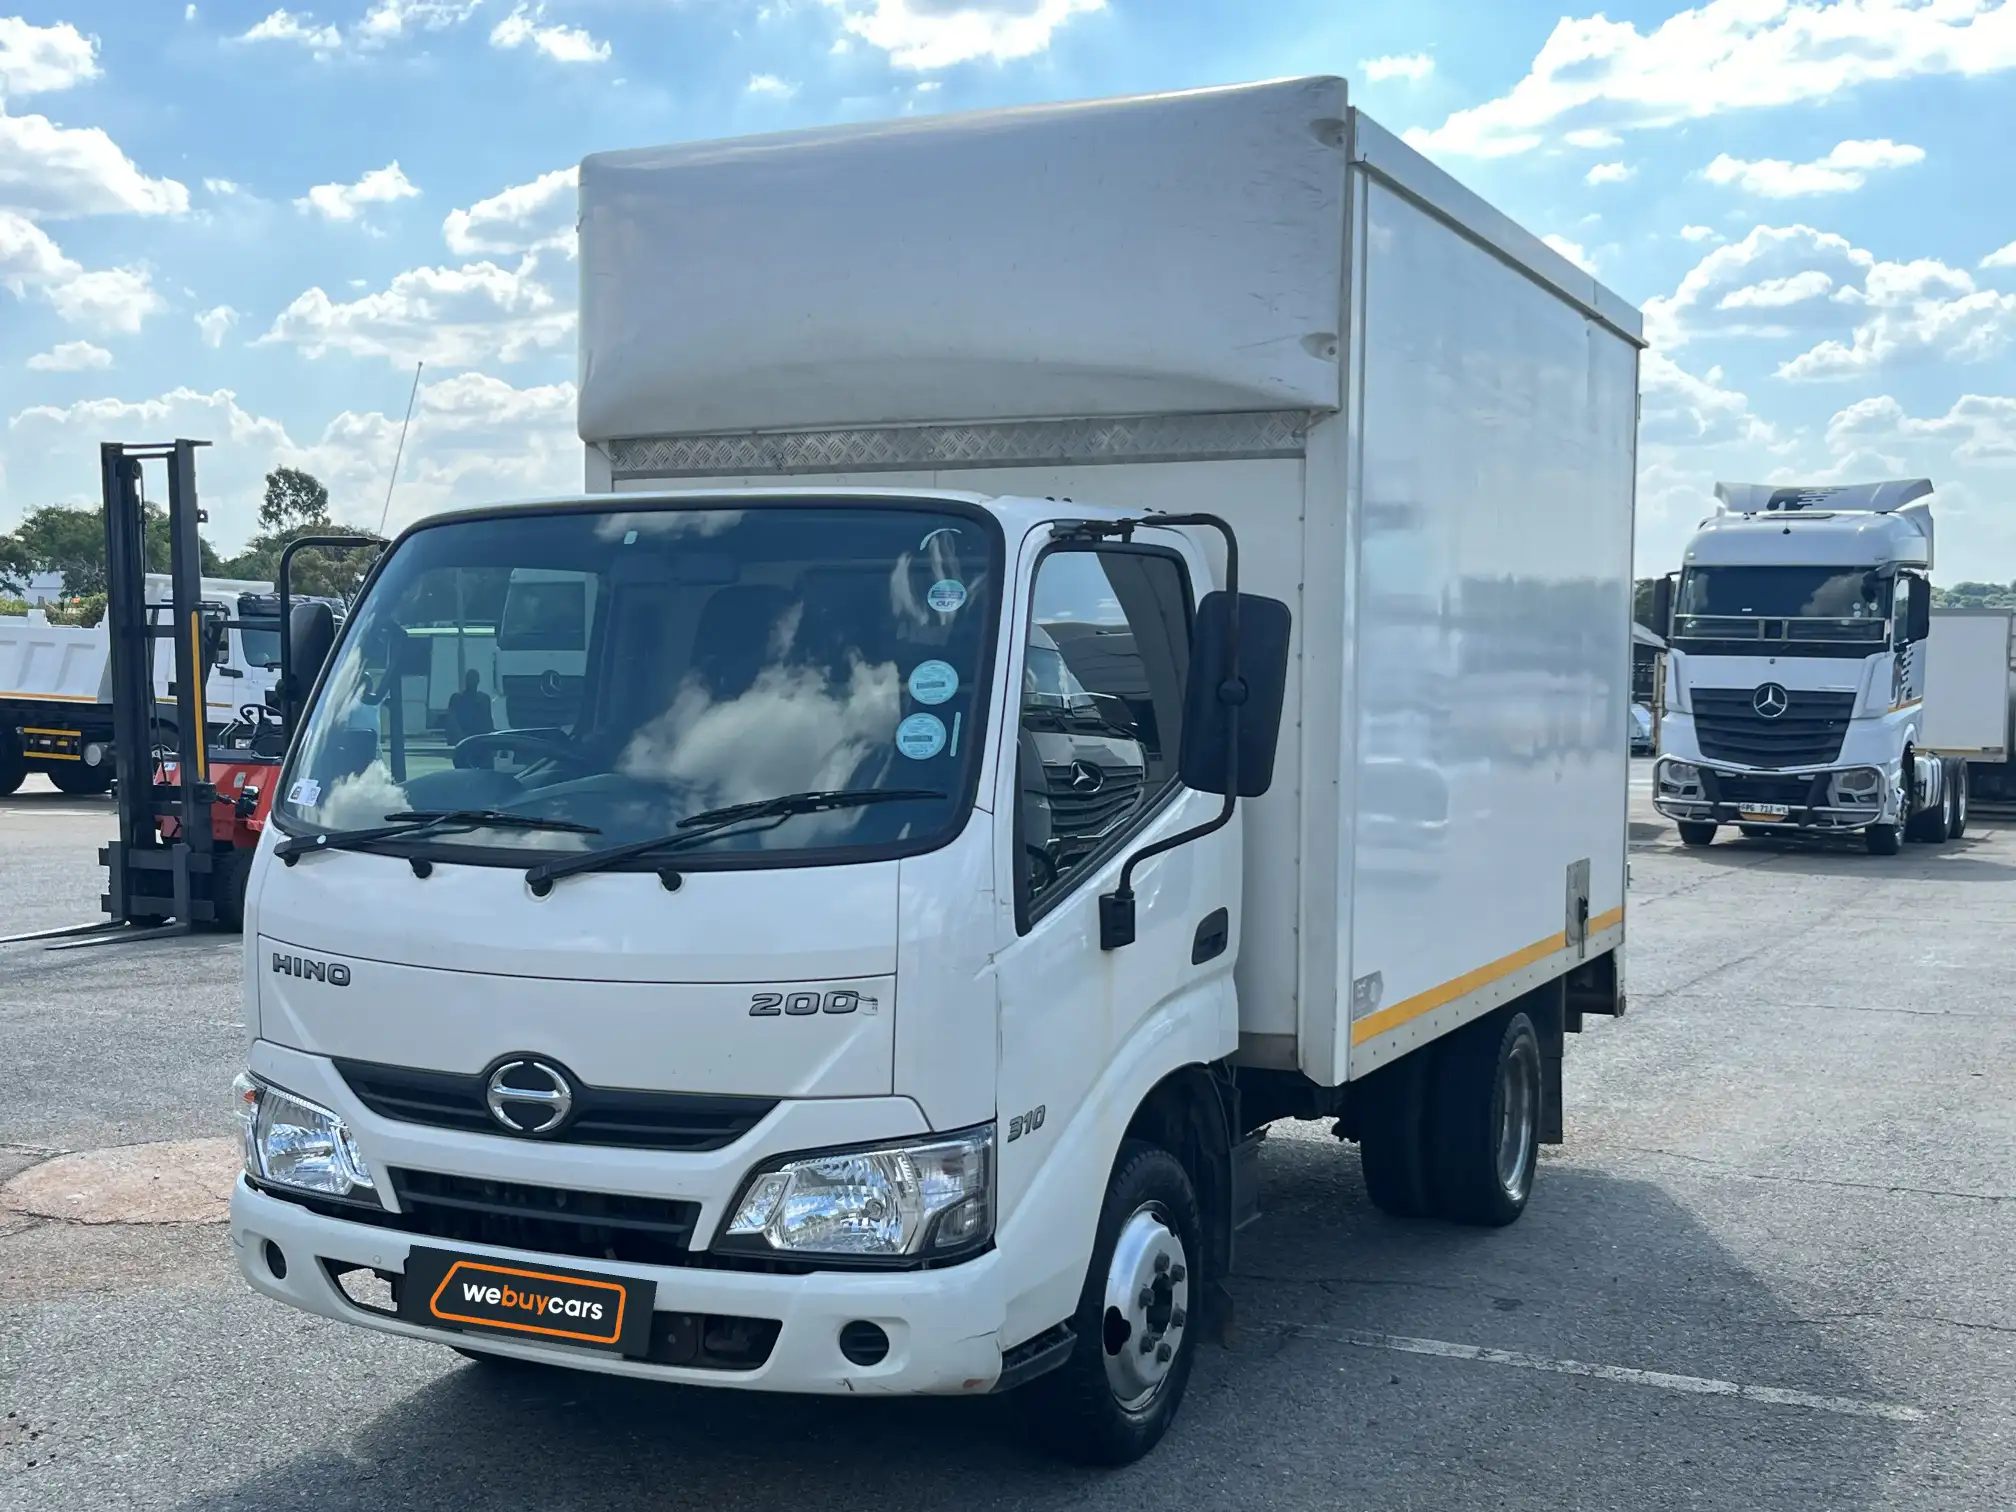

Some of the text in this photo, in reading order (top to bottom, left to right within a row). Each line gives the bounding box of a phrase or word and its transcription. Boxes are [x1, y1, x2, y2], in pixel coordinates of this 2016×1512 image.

[273, 953, 350, 986] HINO
[749, 990, 860, 1016] 200
[1007, 1104, 1046, 1143] 310
[462, 1282, 603, 1320] webuycars
